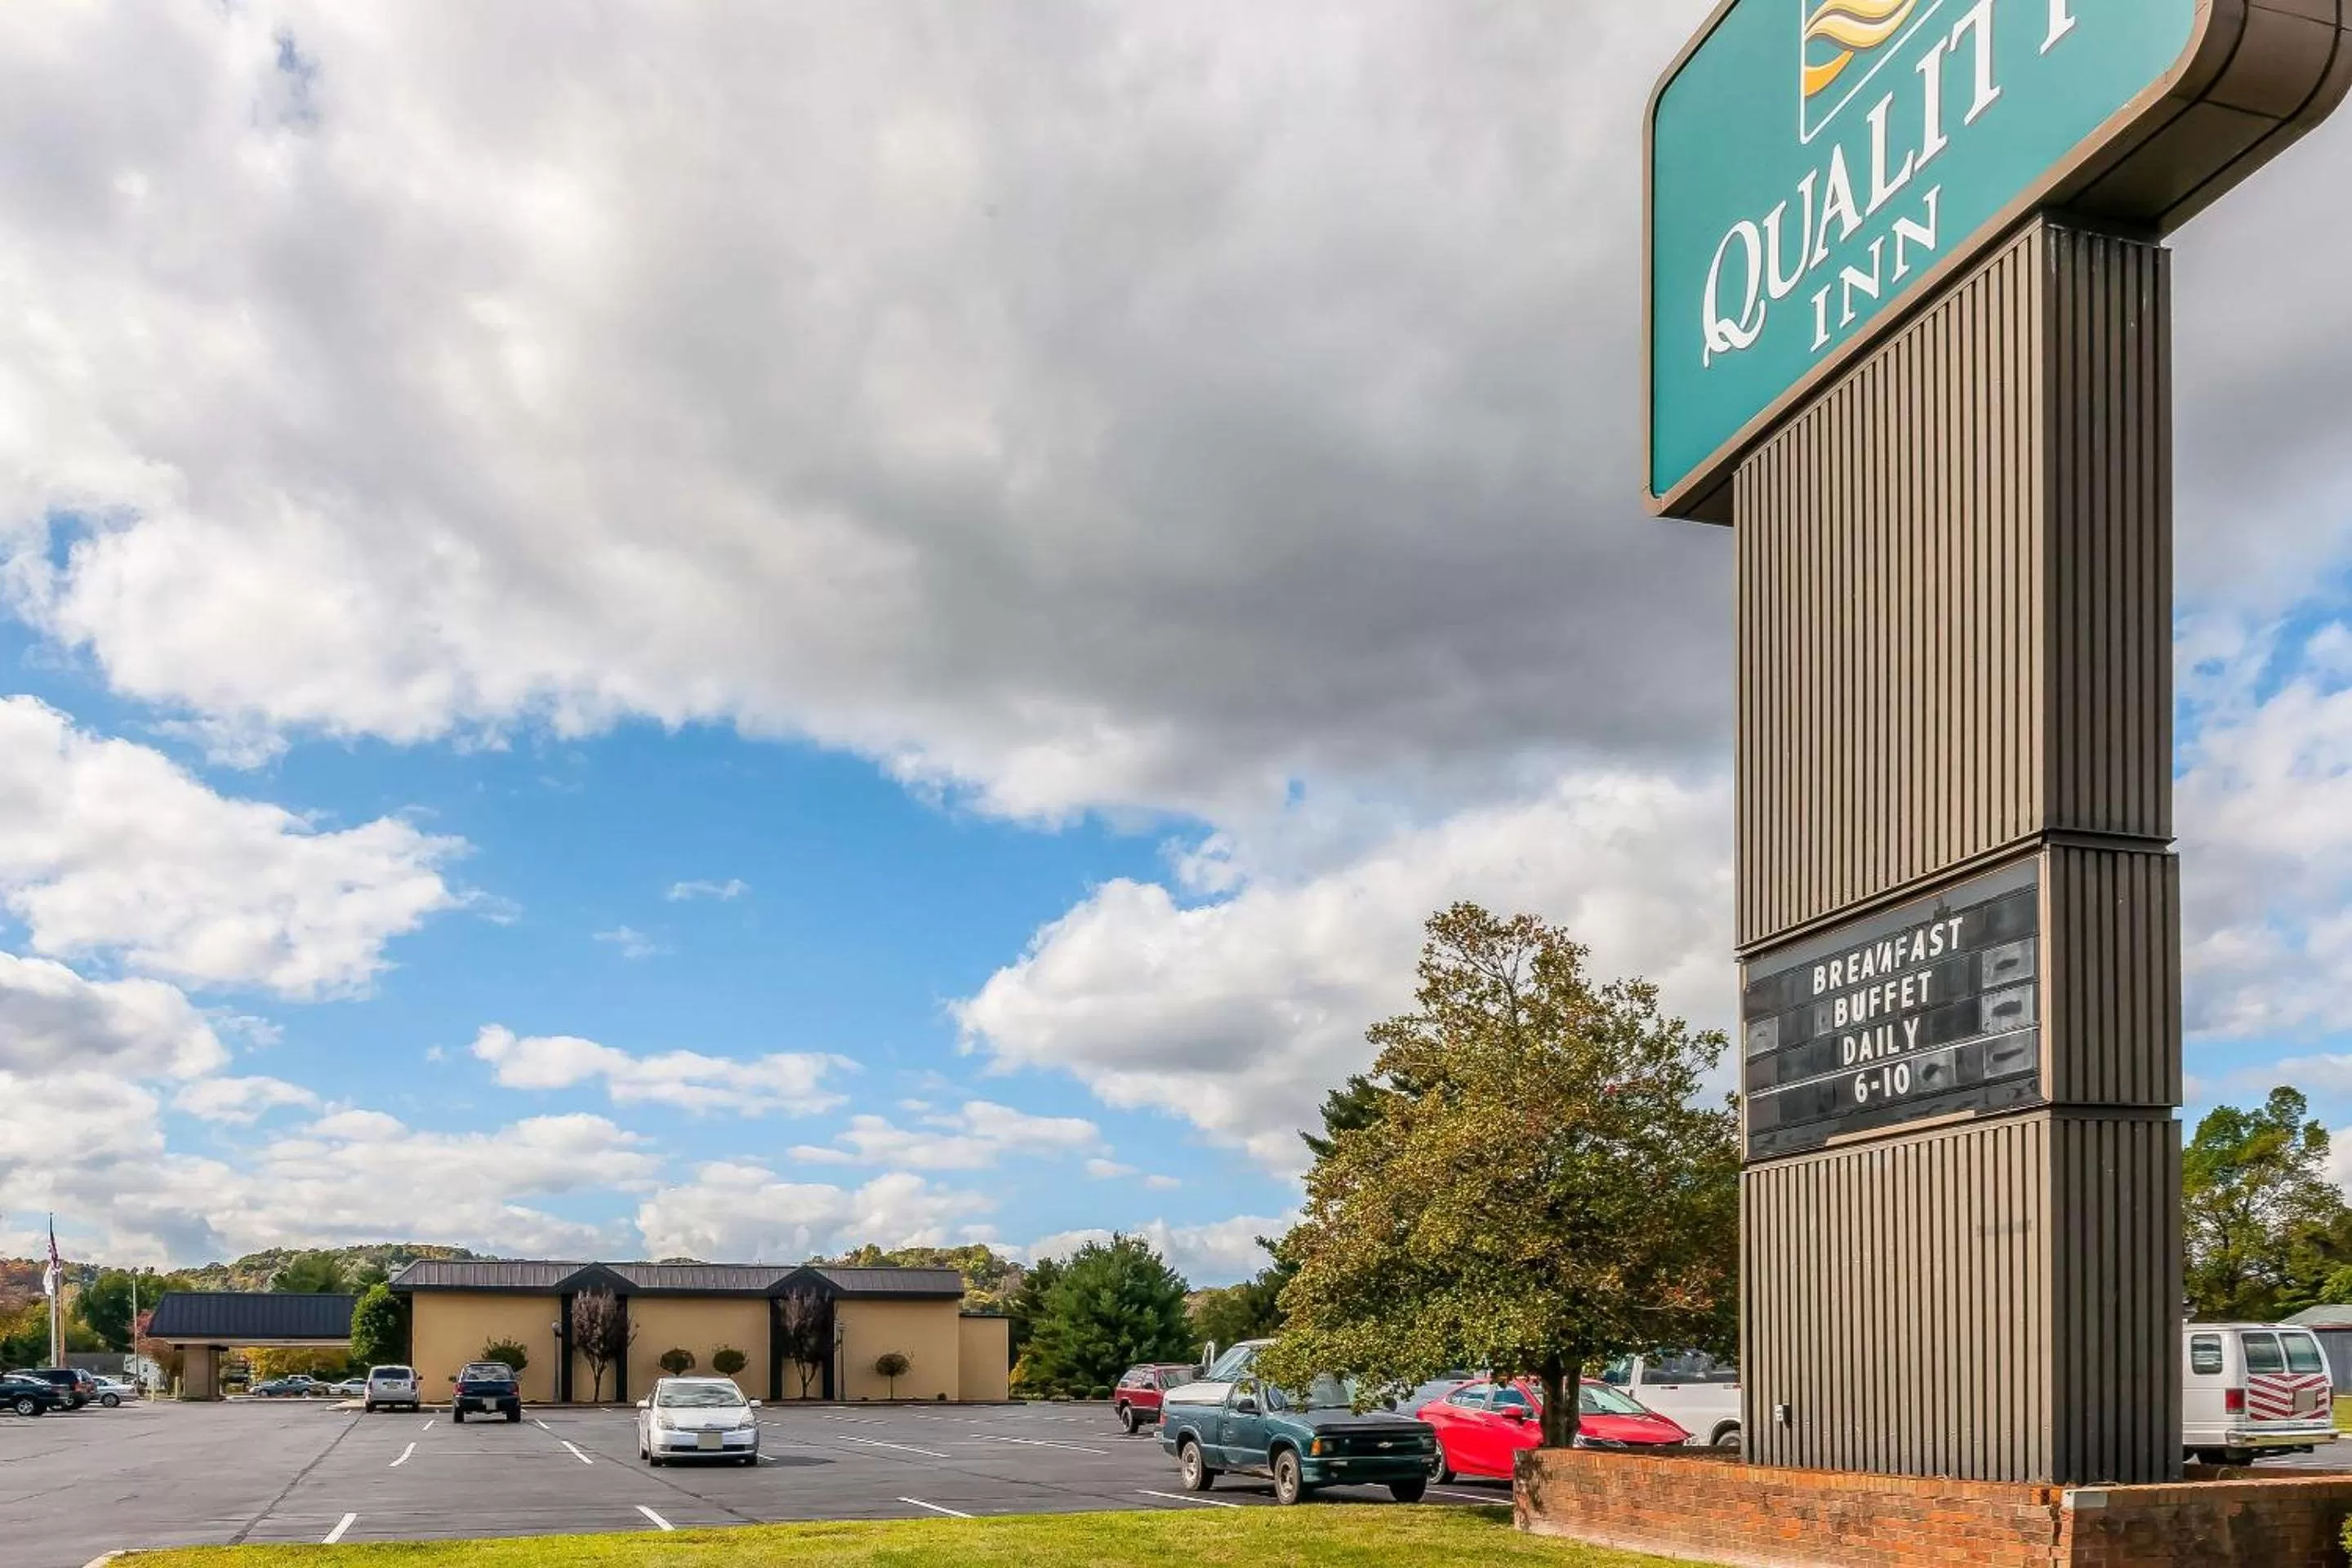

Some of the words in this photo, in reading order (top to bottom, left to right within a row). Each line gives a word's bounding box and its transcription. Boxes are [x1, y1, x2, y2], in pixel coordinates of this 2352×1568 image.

[1811, 186, 1940, 353] INN
[1834, 971, 1932, 1028] BUFFET
[1843, 1018, 1919, 1066] DAILY
[1854, 1063, 1910, 1103] 6-10
